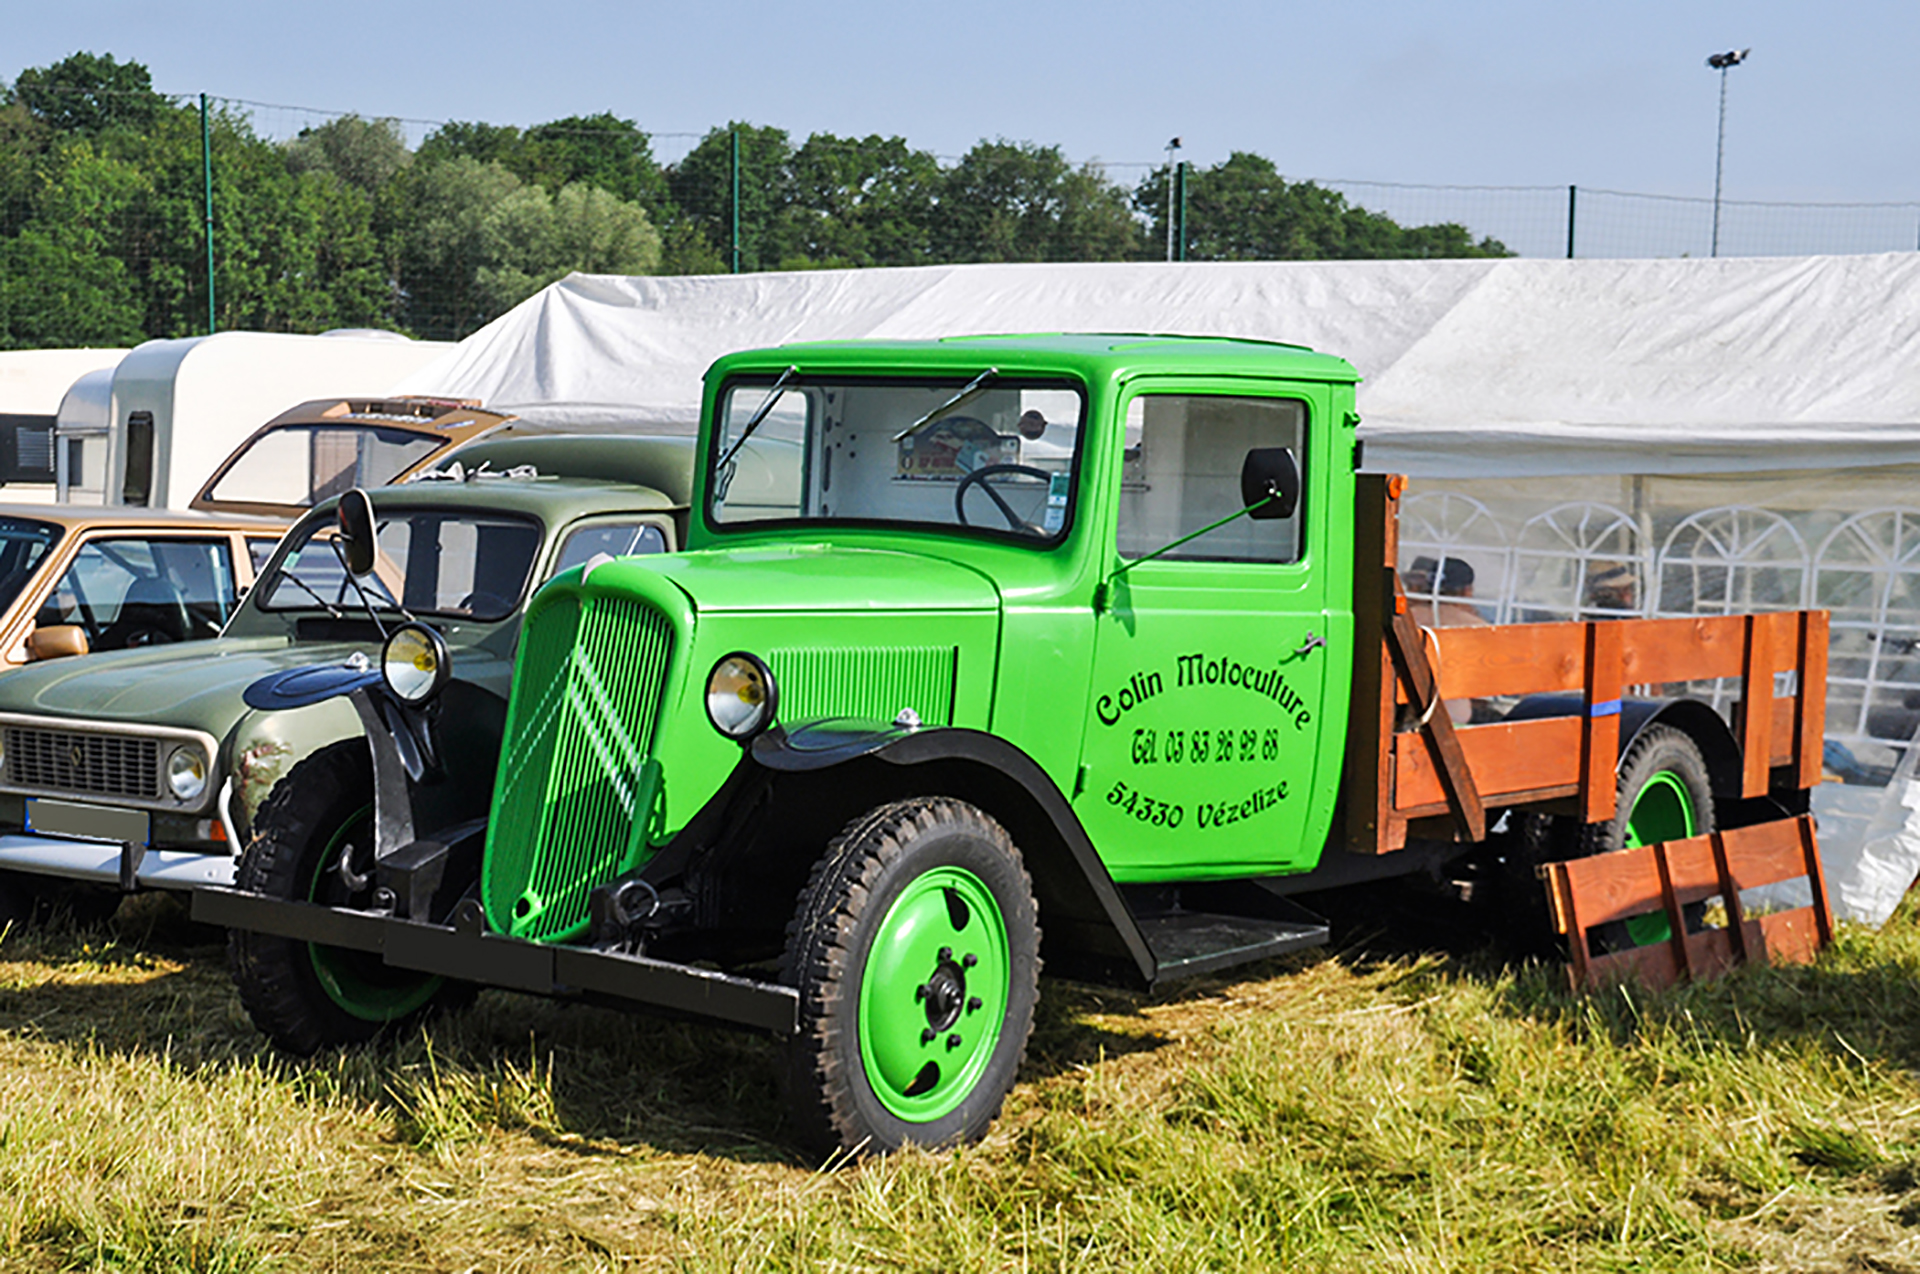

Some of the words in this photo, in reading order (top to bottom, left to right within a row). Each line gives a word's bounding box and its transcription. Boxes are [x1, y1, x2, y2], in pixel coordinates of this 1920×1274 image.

[1096, 672, 1163, 727] Colin
[1177, 654, 1311, 731] Motoculture
[1165, 730, 1184, 763] 03
[1190, 730, 1210, 763] 83
[1106, 781, 1184, 829] 54330
[1197, 780, 1289, 829] Vézelize
